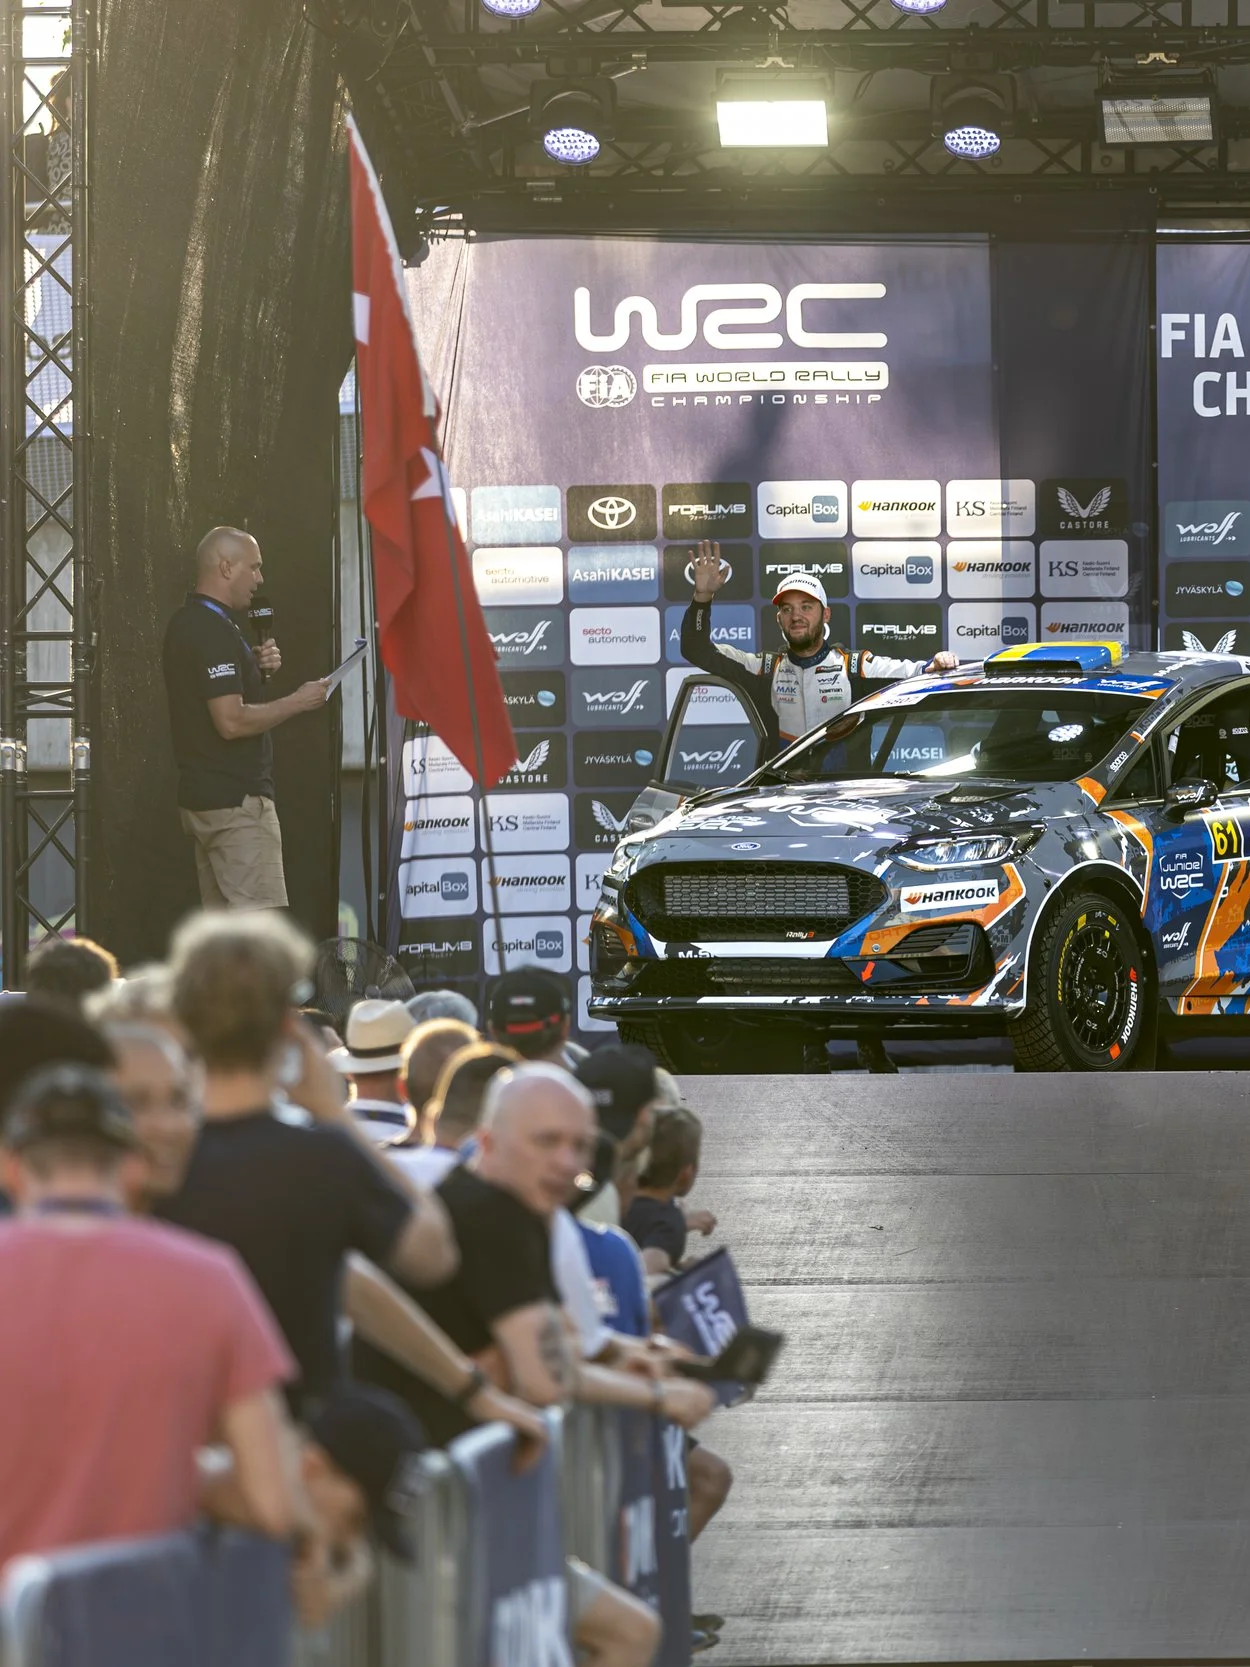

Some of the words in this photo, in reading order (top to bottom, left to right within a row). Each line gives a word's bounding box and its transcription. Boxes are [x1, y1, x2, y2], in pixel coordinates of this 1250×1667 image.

[574, 283, 888, 352] WRC
[1160, 312, 1245, 358] FIA
[651, 372, 687, 383] FIA
[696, 371, 786, 383] WORLD
[795, 370, 881, 382] RALLY
[651, 394, 882, 407] CHAMPIONSHIP
[668, 503, 746, 515] FORUM8
[955, 500, 985, 517] KS
[1059, 521, 1110, 529] CASTORE
[766, 563, 844, 575] FORUM8
[1048, 560, 1079, 577] KS
[1175, 583, 1223, 595] JYVÄSKYLÄ
[582, 627, 612, 635] secto
[862, 624, 937, 635] FORUM8
[588, 634, 647, 644] automotive
[584, 754, 632, 765] JYVÄSKYLÄ
[1110, 751, 1129, 773] sparco
[489, 815, 519, 831] KS
[1211, 819, 1238, 856] 61
[1162, 862, 1200, 872] JUNIOR
[1160, 873, 1204, 890] WRC
[786, 931, 815, 940] Rally3
[398, 941, 472, 954] FORUM8
